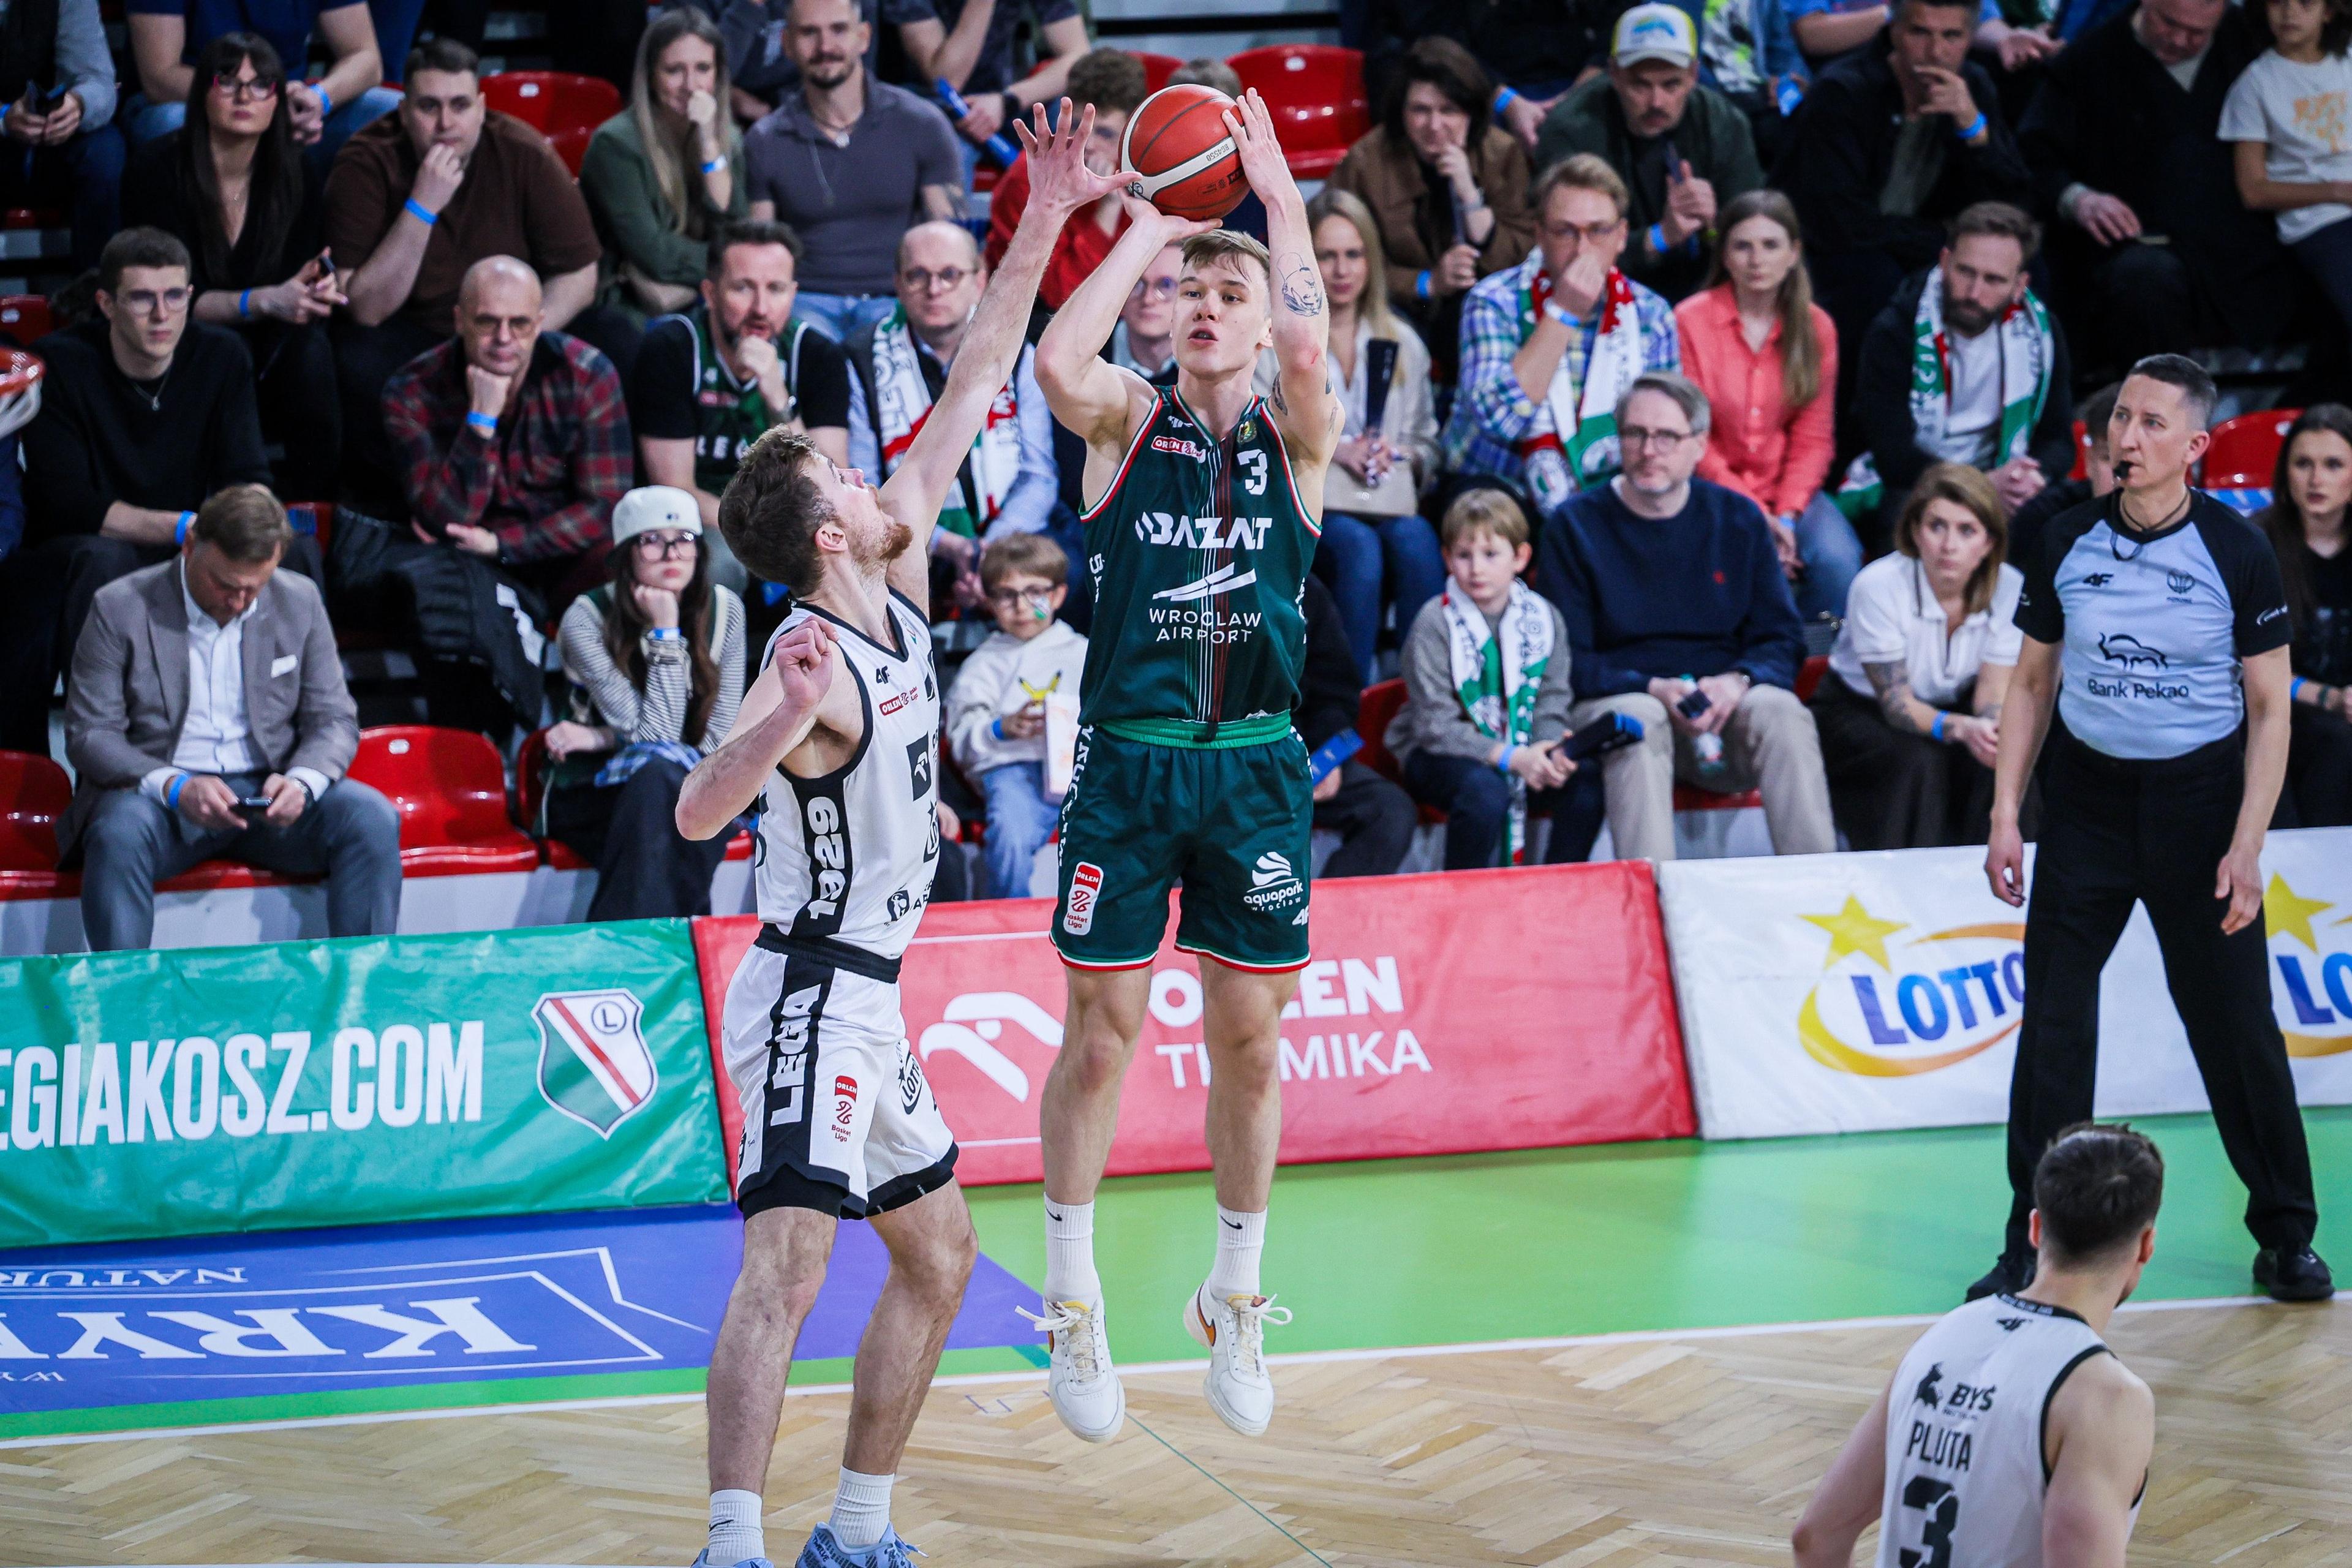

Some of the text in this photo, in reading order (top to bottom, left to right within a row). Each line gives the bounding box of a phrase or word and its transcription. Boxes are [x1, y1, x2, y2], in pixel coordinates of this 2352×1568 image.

[1237, 449, 1267, 495] 3
[1156, 626, 1252, 644] AIRPORT
[2088, 679, 2189, 699] Bank Pekao
[807, 797, 846, 919] 1929
[1077, 871, 1099, 883] ORLEN
[1243, 881, 1303, 907] aquapark
[1068, 919, 1083, 929] Liga
[1149, 956, 1404, 1027] OEN
[1155, 1029, 1433, 1088] TMIKA
[836, 1082, 858, 1094] ORLEN
[831, 1125, 851, 1137] Basket
[835, 1133, 847, 1142] Liga
[1907, 1420, 1971, 1471] PLUTA
[1899, 1475, 1958, 1568] 3
